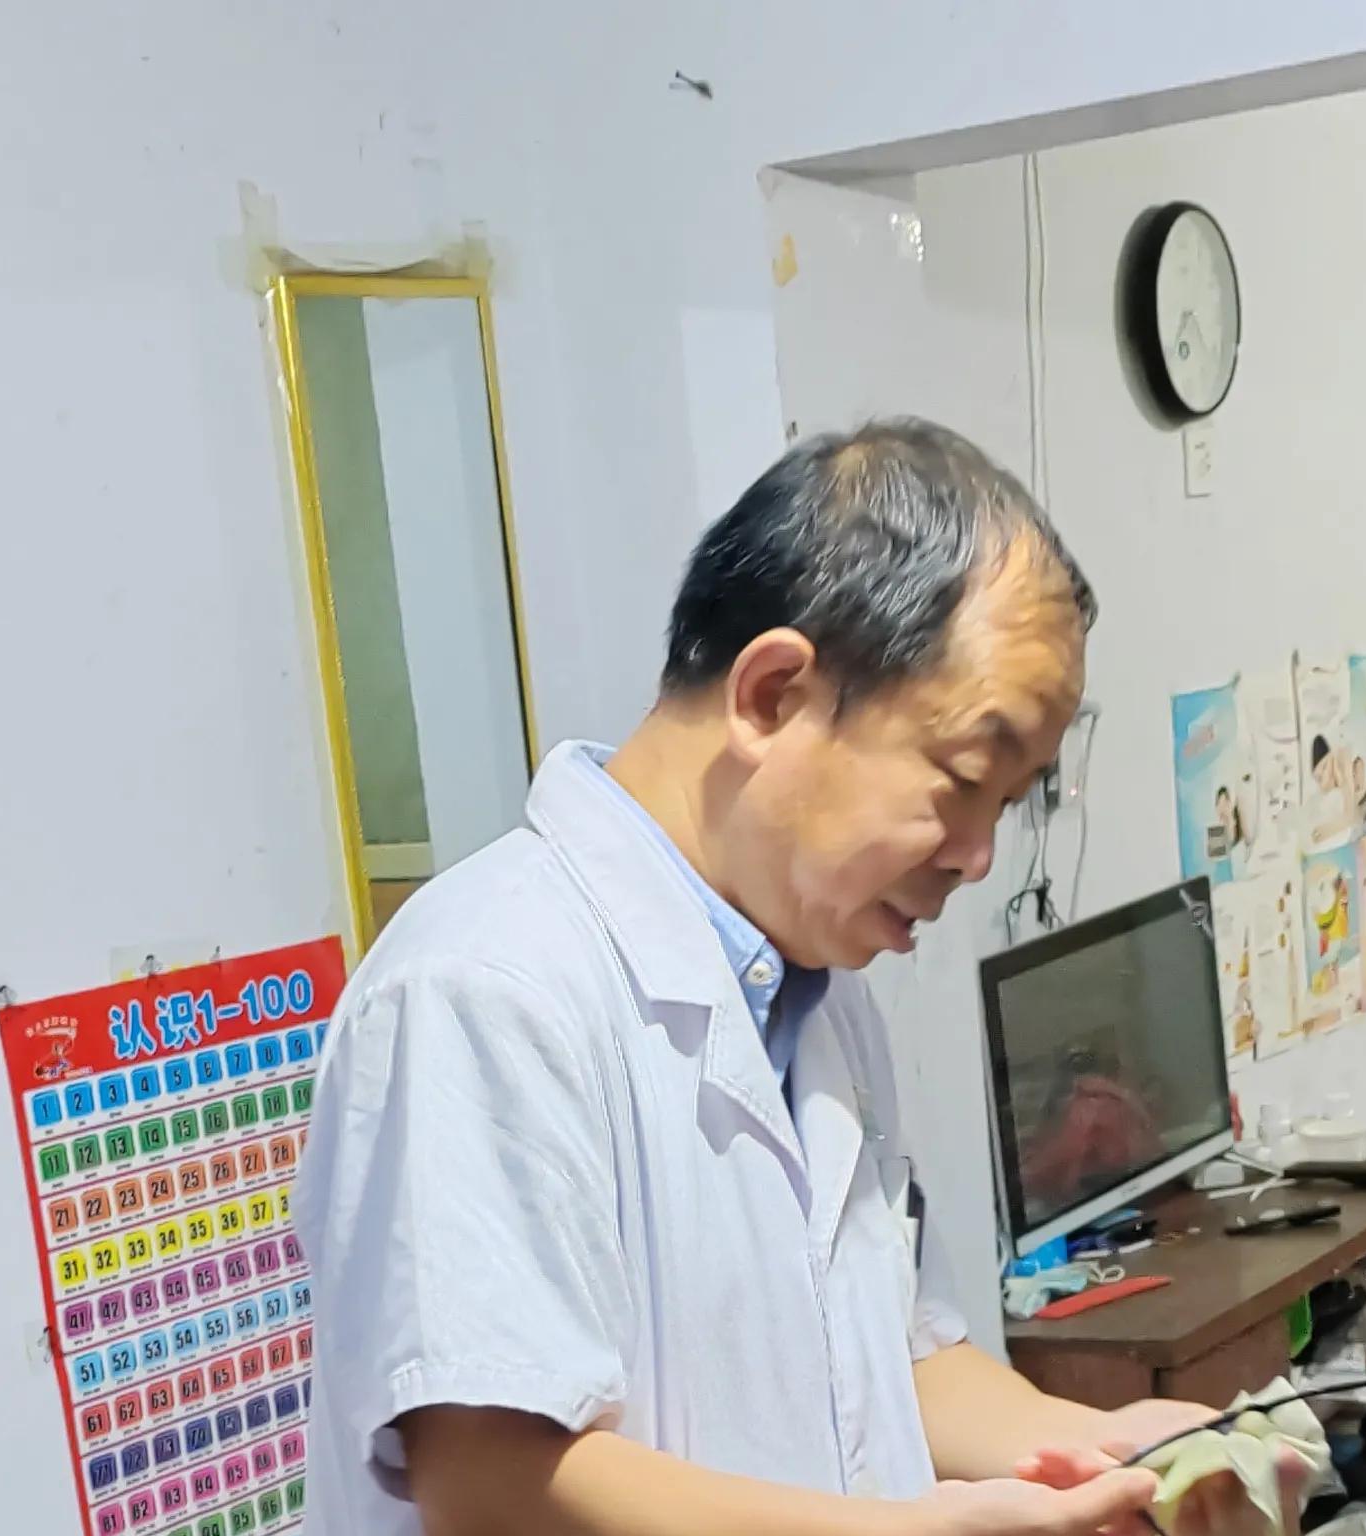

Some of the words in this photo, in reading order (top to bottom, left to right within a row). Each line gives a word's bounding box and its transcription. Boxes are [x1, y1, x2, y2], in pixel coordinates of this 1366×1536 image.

[110, 972, 312, 1058] 认识1-100
[49, 1154, 60, 1169] 11
[79, 1146, 93, 1163] 12
[111, 1138, 125, 1154] 13
[144, 1128, 159, 1145] 14
[177, 1120, 191, 1138] 15
[209, 1113, 223, 1130] 16
[238, 1104, 251, 1123] 17
[56, 1209, 69, 1226] 21
[87, 1199, 101, 1216] 22
[119, 1190, 135, 1206] 23
[152, 1181, 167, 1198] 24
[183, 1170, 199, 1188] 25
[214, 1161, 230, 1179] 26
[245, 1153, 258, 1171] 27
[64, 1261, 78, 1279] 31
[96, 1251, 112, 1269] 32
[129, 1240, 144, 1258] 33
[159, 1230, 175, 1246] 34
[190, 1221, 207, 1239] 35
[222, 1211, 238, 1229] 36
[252, 1202, 266, 1220] 37
[69, 1312, 84, 1329] 41
[102, 1301, 118, 1318] 42
[136, 1290, 152, 1308] 43
[166, 1281, 182, 1297] 44
[196, 1270, 212, 1288] 45
[227, 1260, 243, 1277] 46
[259, 1249, 271, 1267] 47
[80, 1364, 95, 1381] 51
[112, 1352, 129, 1369] 52
[146, 1340, 161, 1359] 53
[176, 1331, 192, 1349] 54
[207, 1319, 223, 1337] 55
[237, 1309, 252, 1327] 56
[267, 1299, 280, 1316] 57
[88, 1414, 102, 1432] 61
[119, 1403, 135, 1421] 62
[151, 1391, 167, 1408] 63
[214, 1368, 229, 1384] 65
